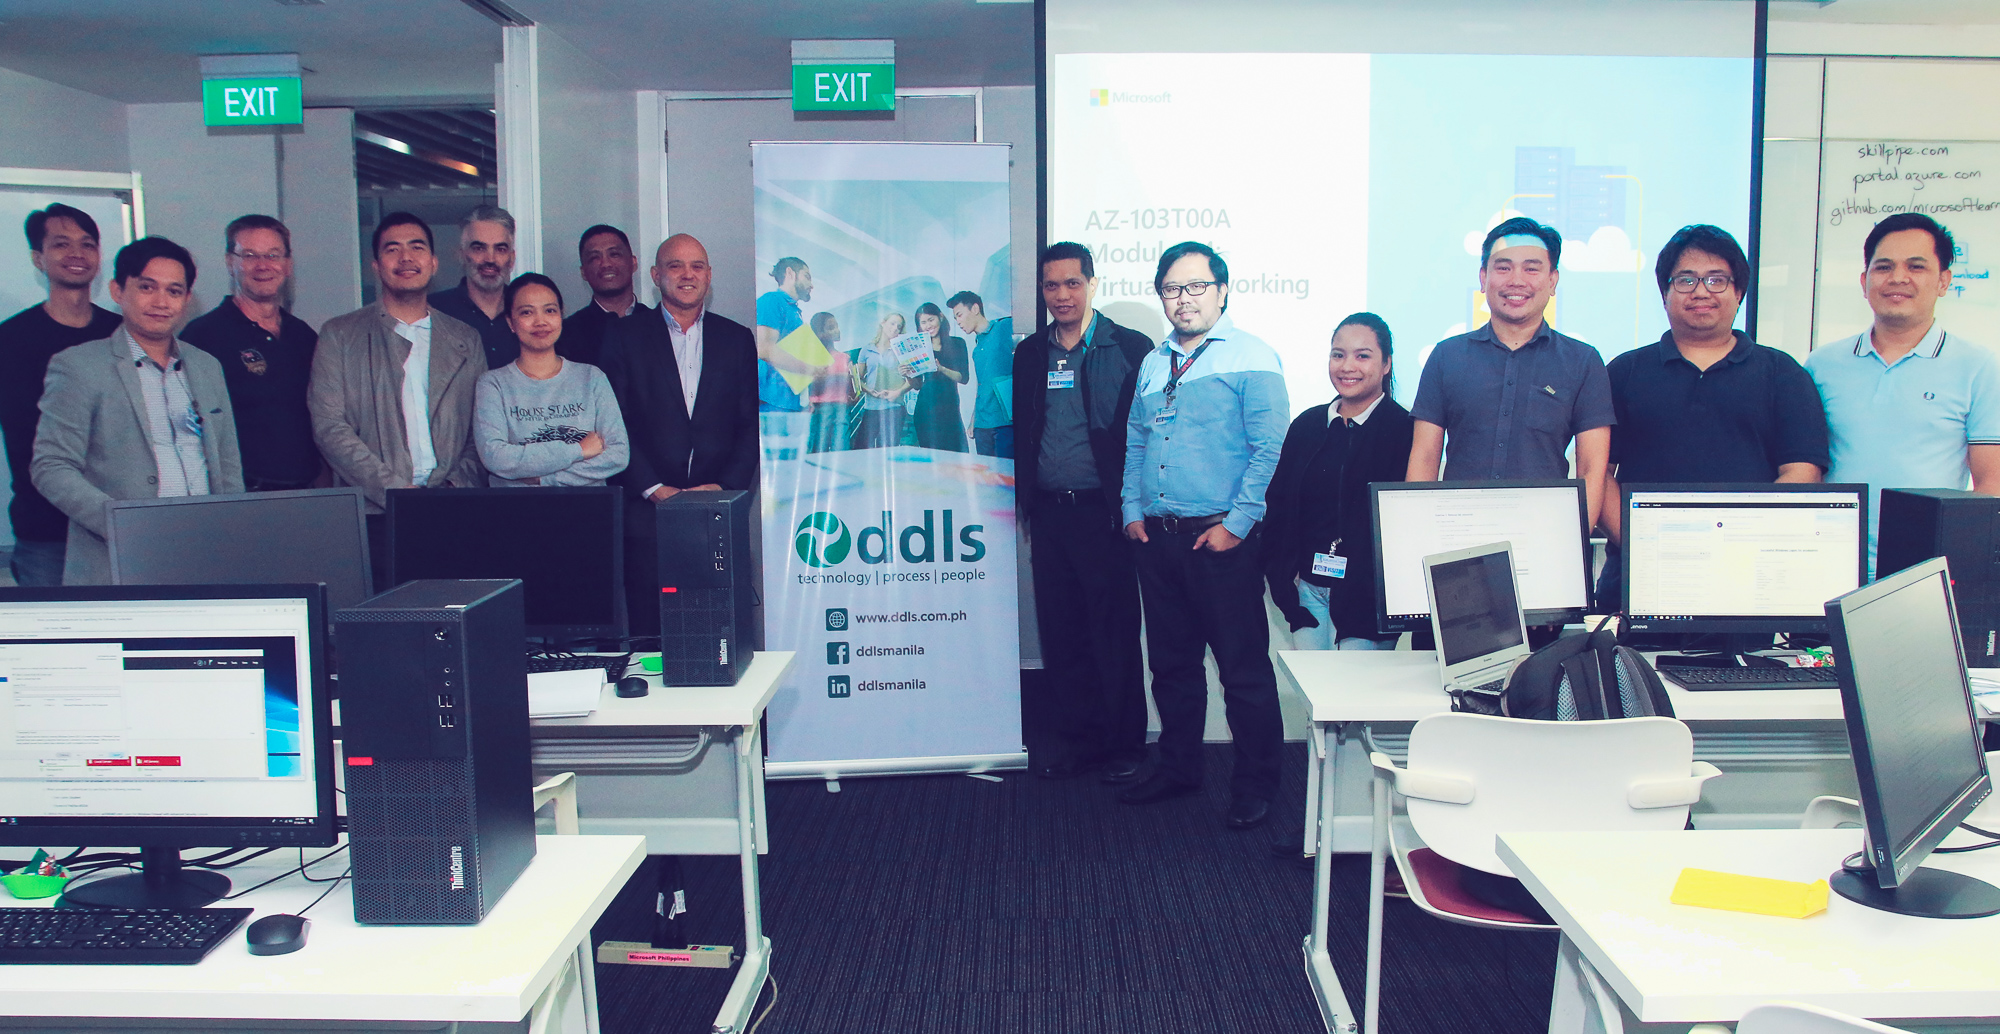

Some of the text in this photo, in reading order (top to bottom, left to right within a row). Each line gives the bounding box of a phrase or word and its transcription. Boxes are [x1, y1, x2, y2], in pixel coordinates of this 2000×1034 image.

[814, 72, 872, 102] EXIT
[1112, 91, 1172, 104] Microsoft
[223, 86, 279, 117] EXIT
[1858, 143, 1949, 165] skillpipe.com
[1852, 167, 1982, 194] portal.azure.com
[1084, 208, 1231, 231] AZ-103T00A
[1086, 240, 1164, 263] Modul
[547, 403, 585, 415] STARK
[856, 509, 987, 565] ddls
[797, 568, 986, 585] technology process people
[856, 610, 967, 624] www.ddls.com.ph
[856, 645, 925, 657] ddlsmanila
[857, 679, 926, 691] ddlsmanila
[450, 846, 465, 890] ThinkCentre
